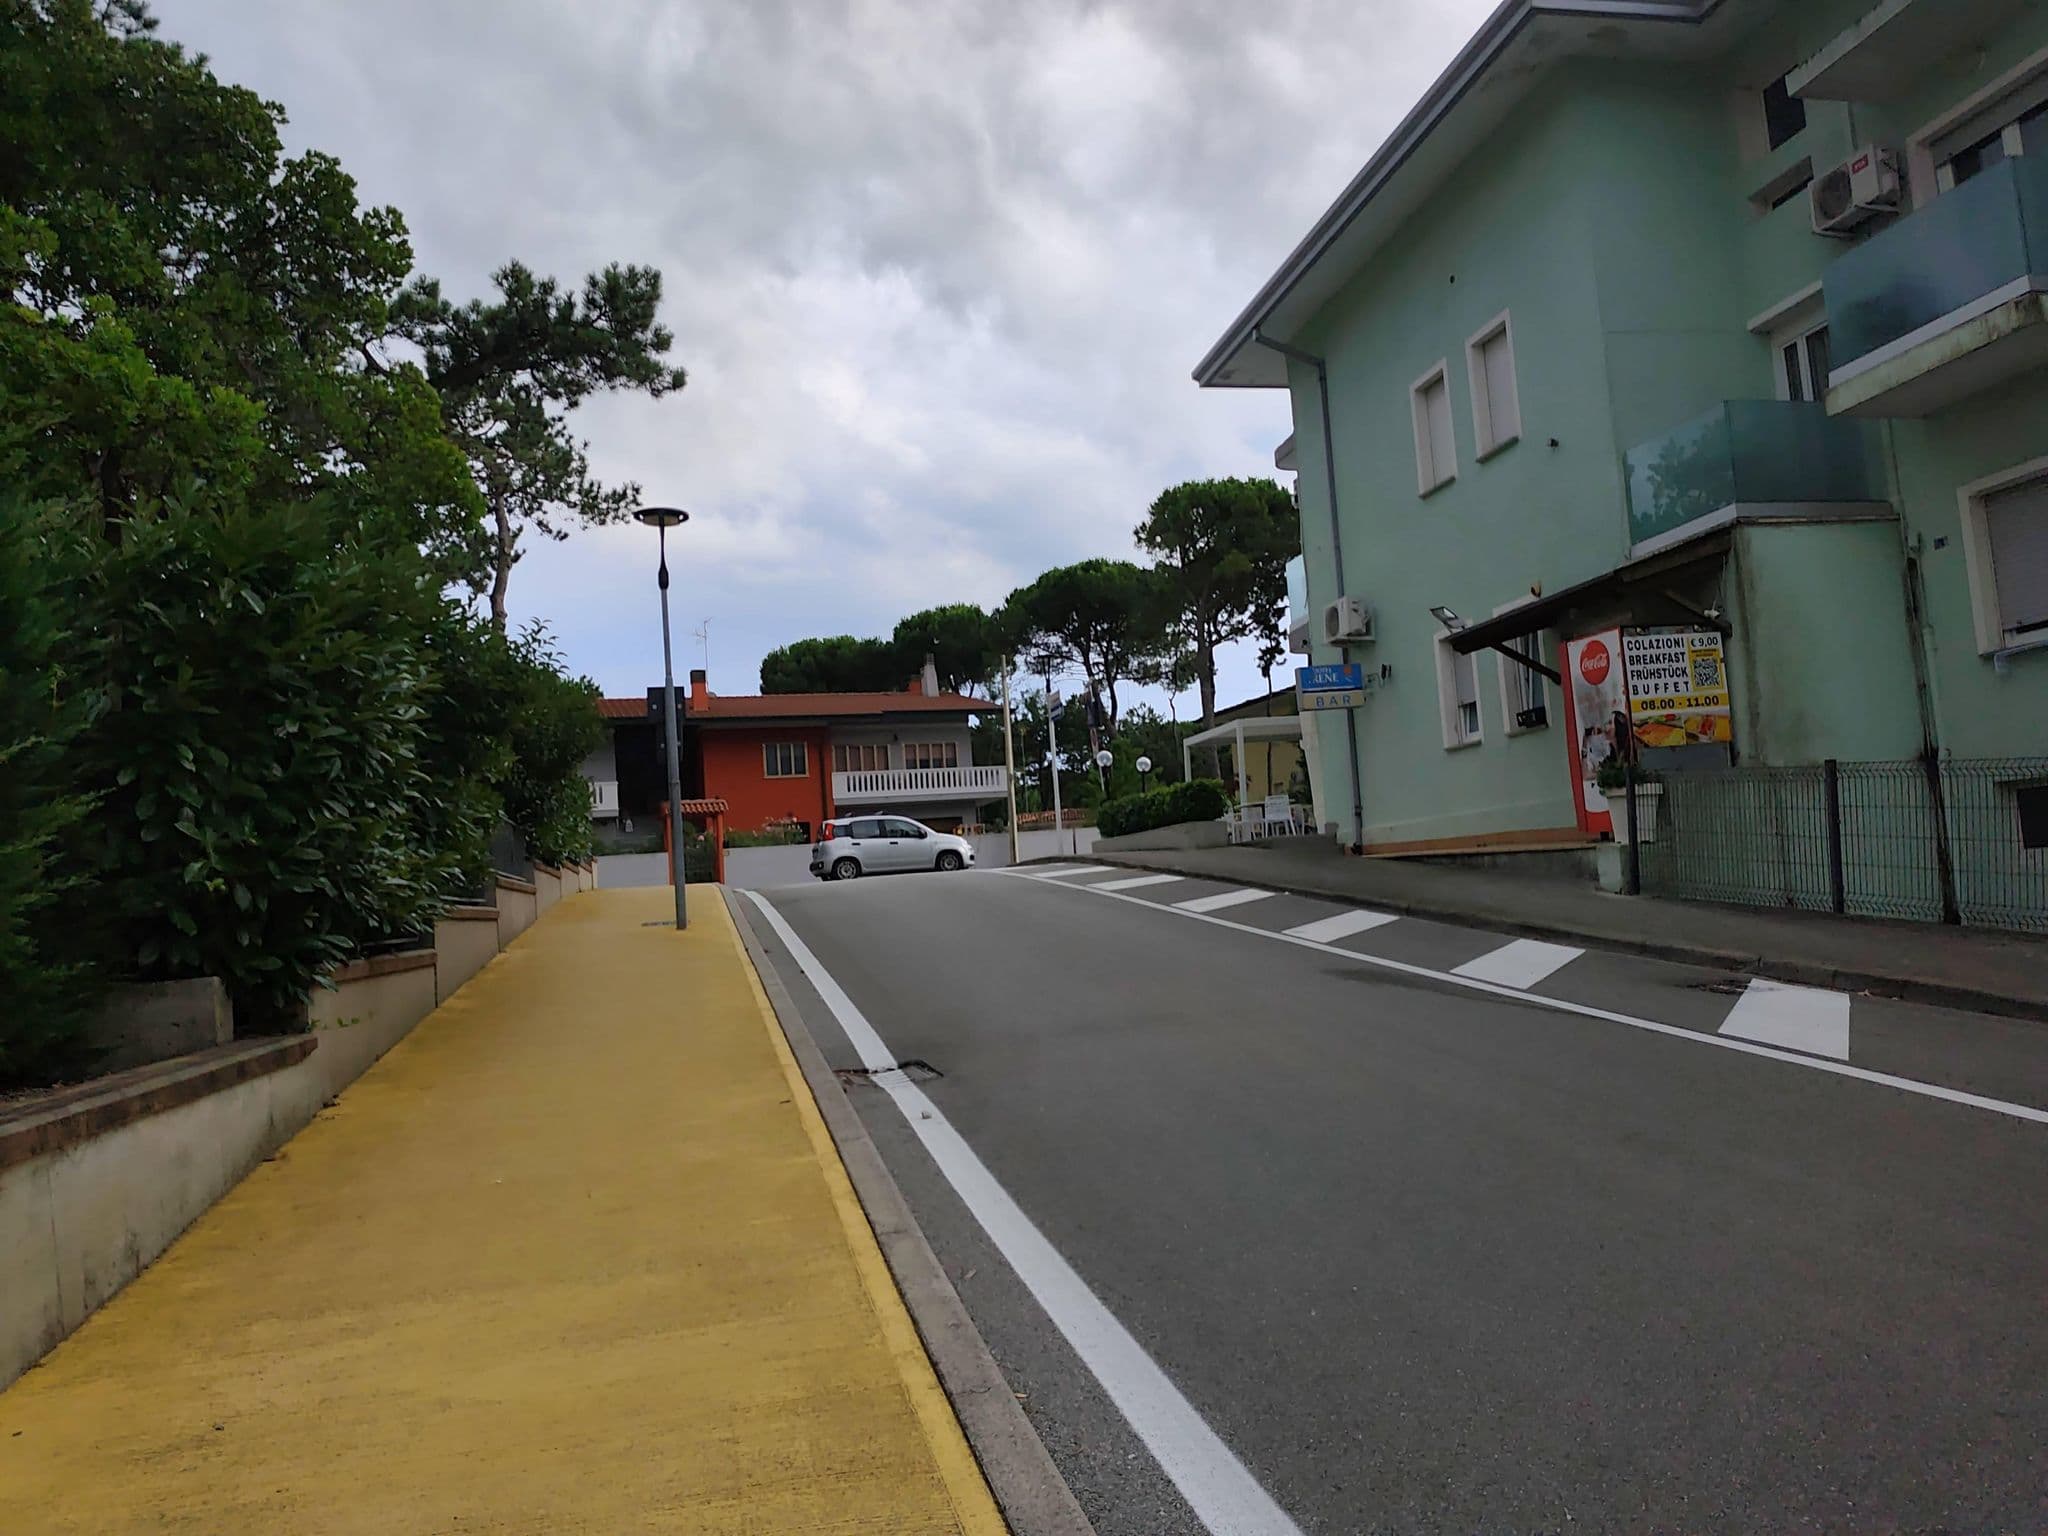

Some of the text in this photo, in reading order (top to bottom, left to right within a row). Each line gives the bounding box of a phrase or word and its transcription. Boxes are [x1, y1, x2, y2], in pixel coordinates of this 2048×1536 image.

[1627, 637, 1685, 651] COLAZIONI
[1698, 636, 1719, 648] 9,00
[1628, 651, 1687, 666] BREAKFAST
[1630, 665, 1689, 681] FRÜHSTÜCK
[1632, 681, 1690, 696] BUFFET
[1315, 694, 1352, 708] BAR
[1641, 698, 1675, 711] 08.00
[1686, 695, 1720, 707] 11.00
